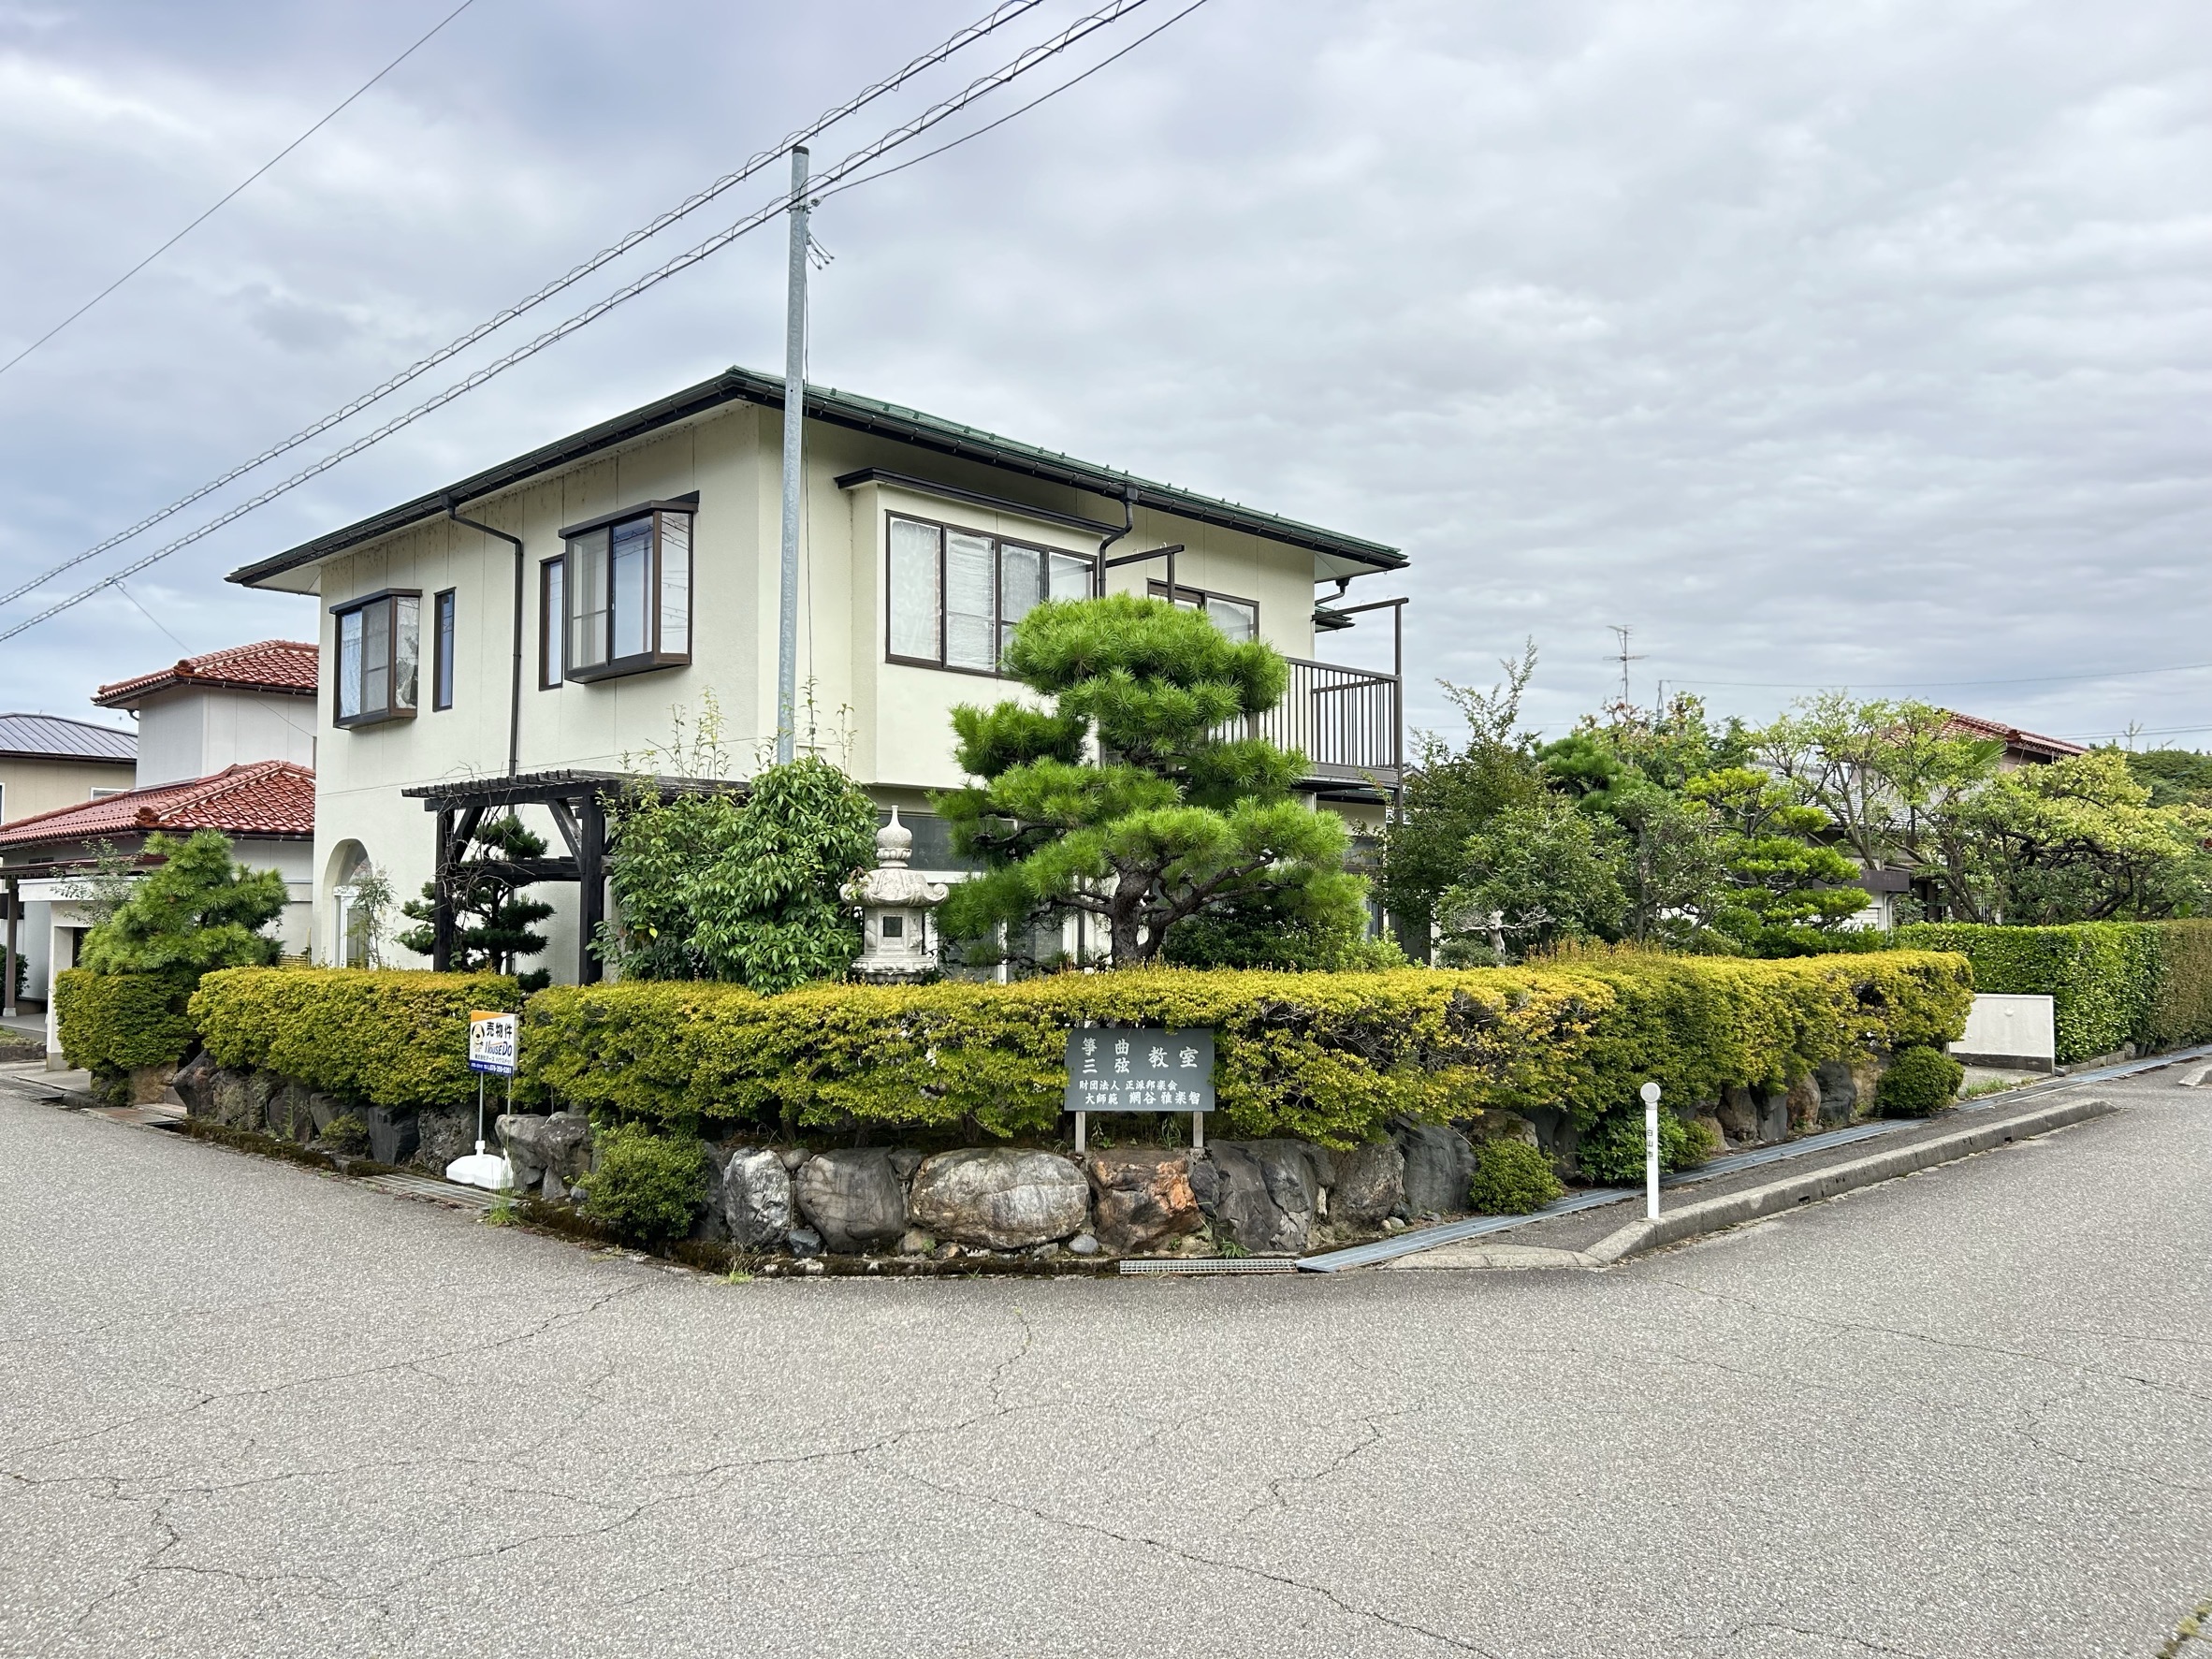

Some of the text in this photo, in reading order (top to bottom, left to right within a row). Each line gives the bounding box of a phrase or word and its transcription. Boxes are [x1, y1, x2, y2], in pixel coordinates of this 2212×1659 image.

[487, 1021, 512, 1039] 売物件
[1082, 1057, 1130, 1073] 三弦
[1148, 1046, 1199, 1069] 教室
[1079, 1080, 1178, 1091] 財団法人 正派邦楽会
[1084, 1092, 1119, 1105] 大師範
